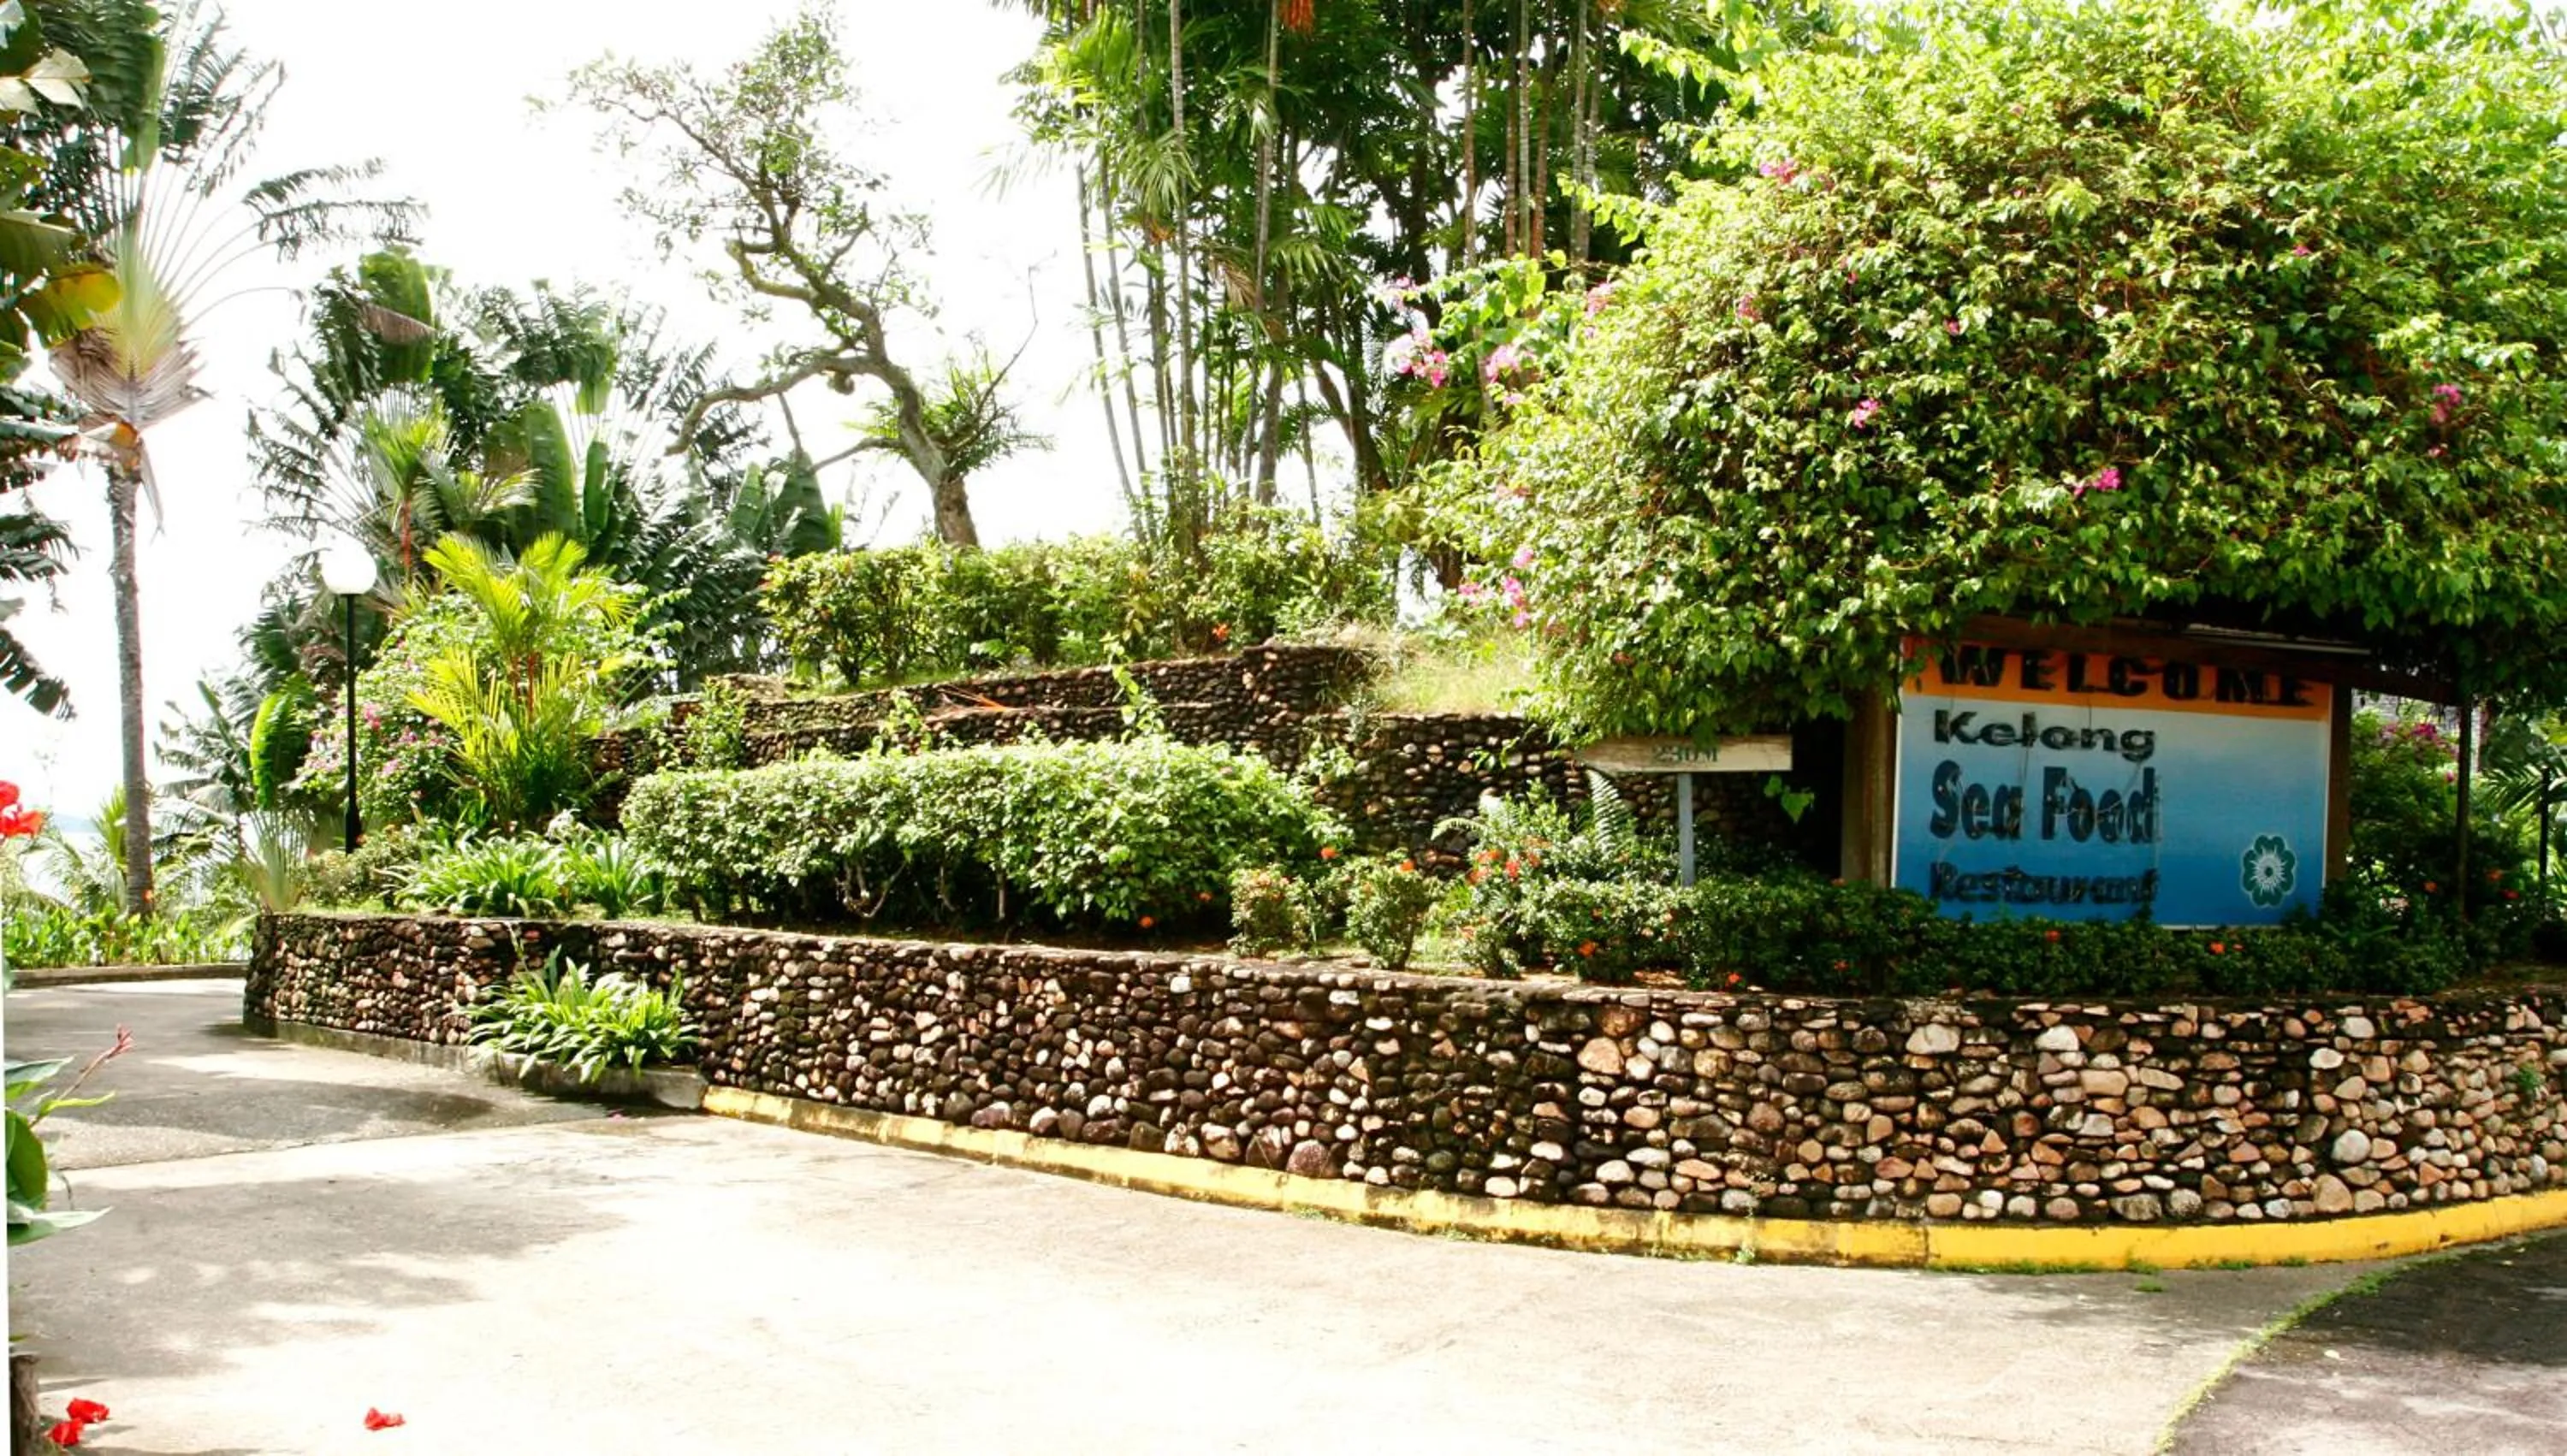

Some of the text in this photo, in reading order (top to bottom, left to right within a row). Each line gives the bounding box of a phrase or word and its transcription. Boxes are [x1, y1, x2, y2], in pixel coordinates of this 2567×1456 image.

[1938, 646, 2315, 707] WELCOME
[1934, 709, 2155, 761] Kelong
[1930, 760, 2157, 843] Sea Food
[1930, 861, 2157, 904] Restaurant
